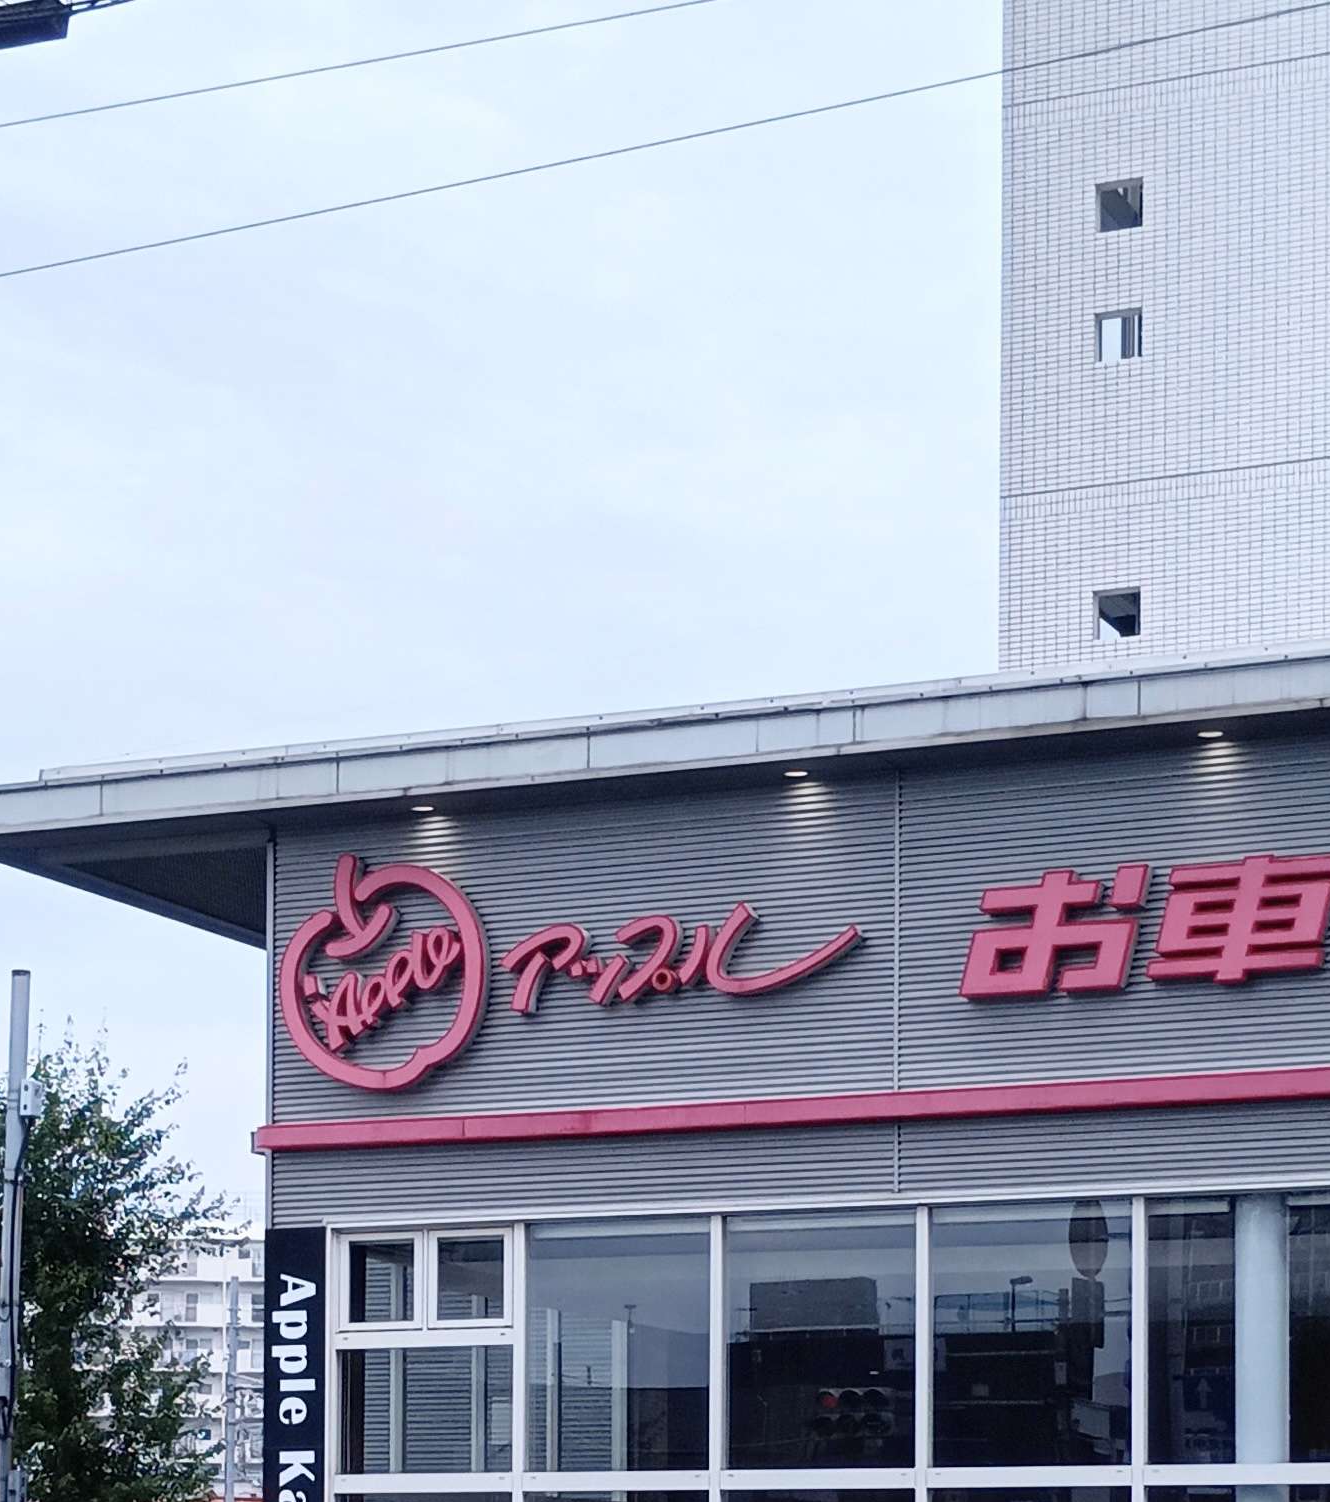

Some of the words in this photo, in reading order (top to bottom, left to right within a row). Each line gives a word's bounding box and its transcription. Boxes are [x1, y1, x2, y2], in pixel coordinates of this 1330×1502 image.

[306, 925, 462, 1054] Apple
[500, 900, 867, 1014] アップル
[271, 1272, 317, 1426] Apple
